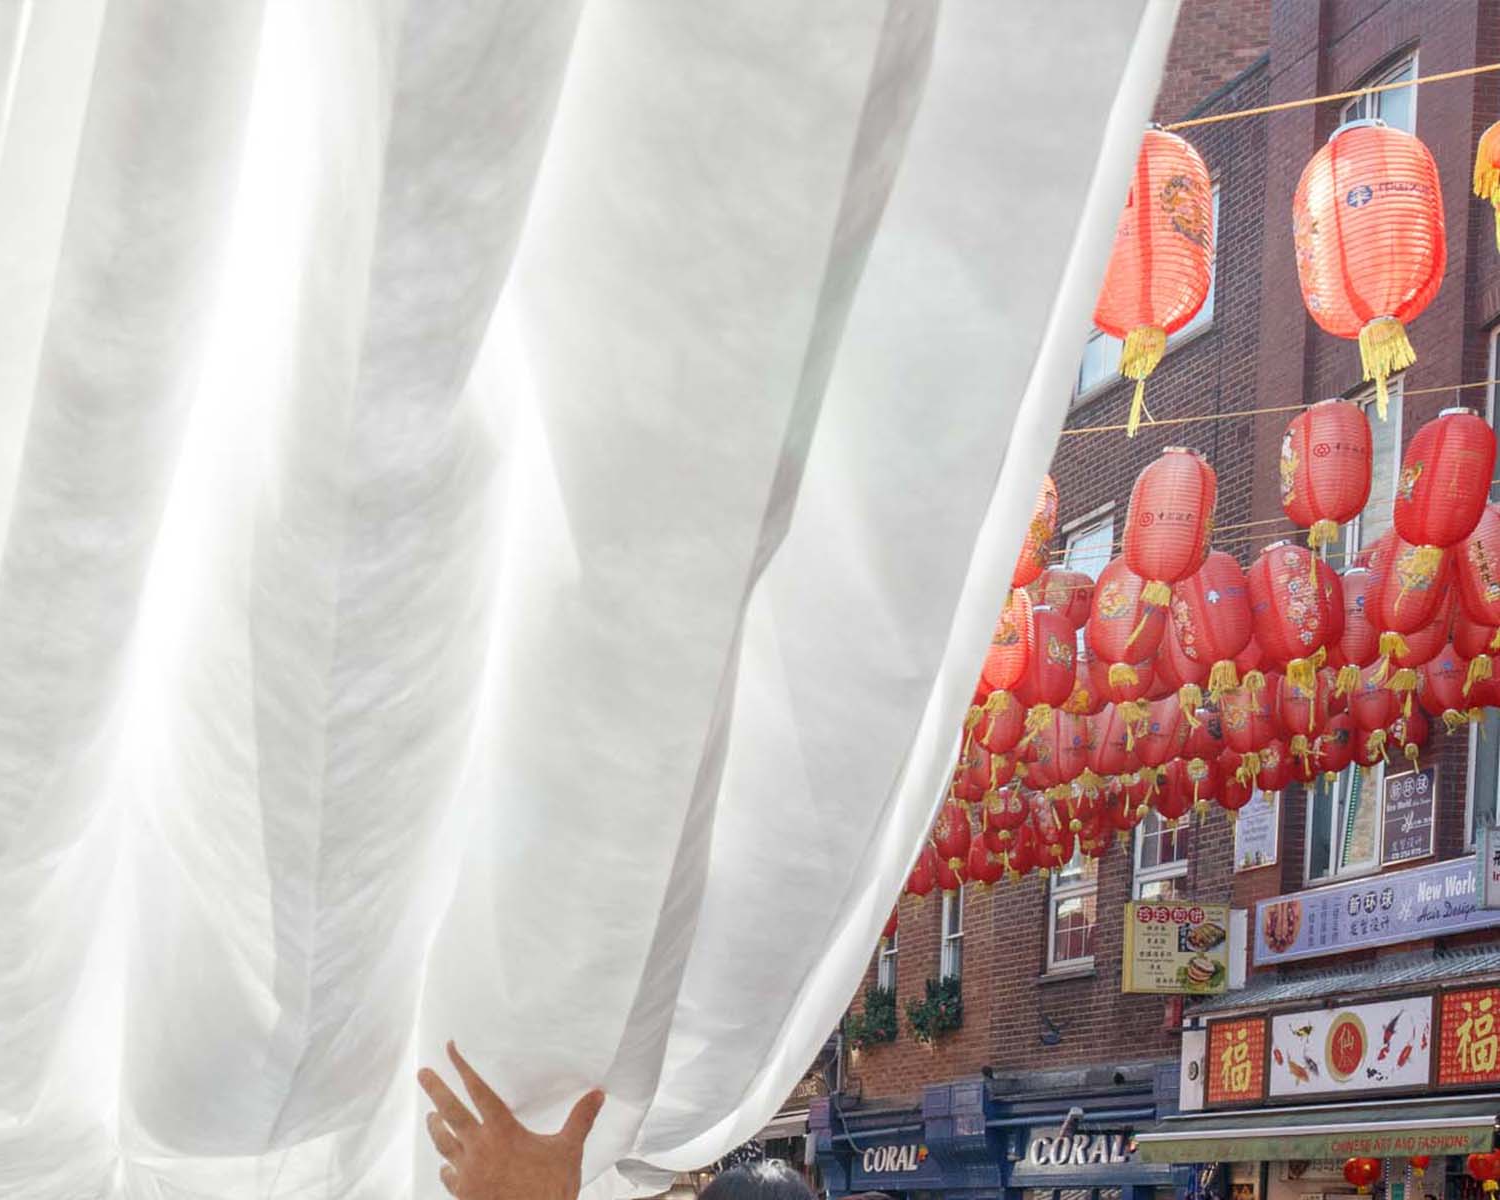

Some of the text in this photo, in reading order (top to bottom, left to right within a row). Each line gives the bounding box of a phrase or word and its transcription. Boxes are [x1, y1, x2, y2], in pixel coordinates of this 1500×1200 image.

[1417, 880, 1443, 904] New
[1456, 997, 1500, 1073] 福
[1220, 1029, 1252, 1092] 福
[863, 1144, 918, 1173] CORAL
[1030, 1133, 1129, 1166] CORAL
